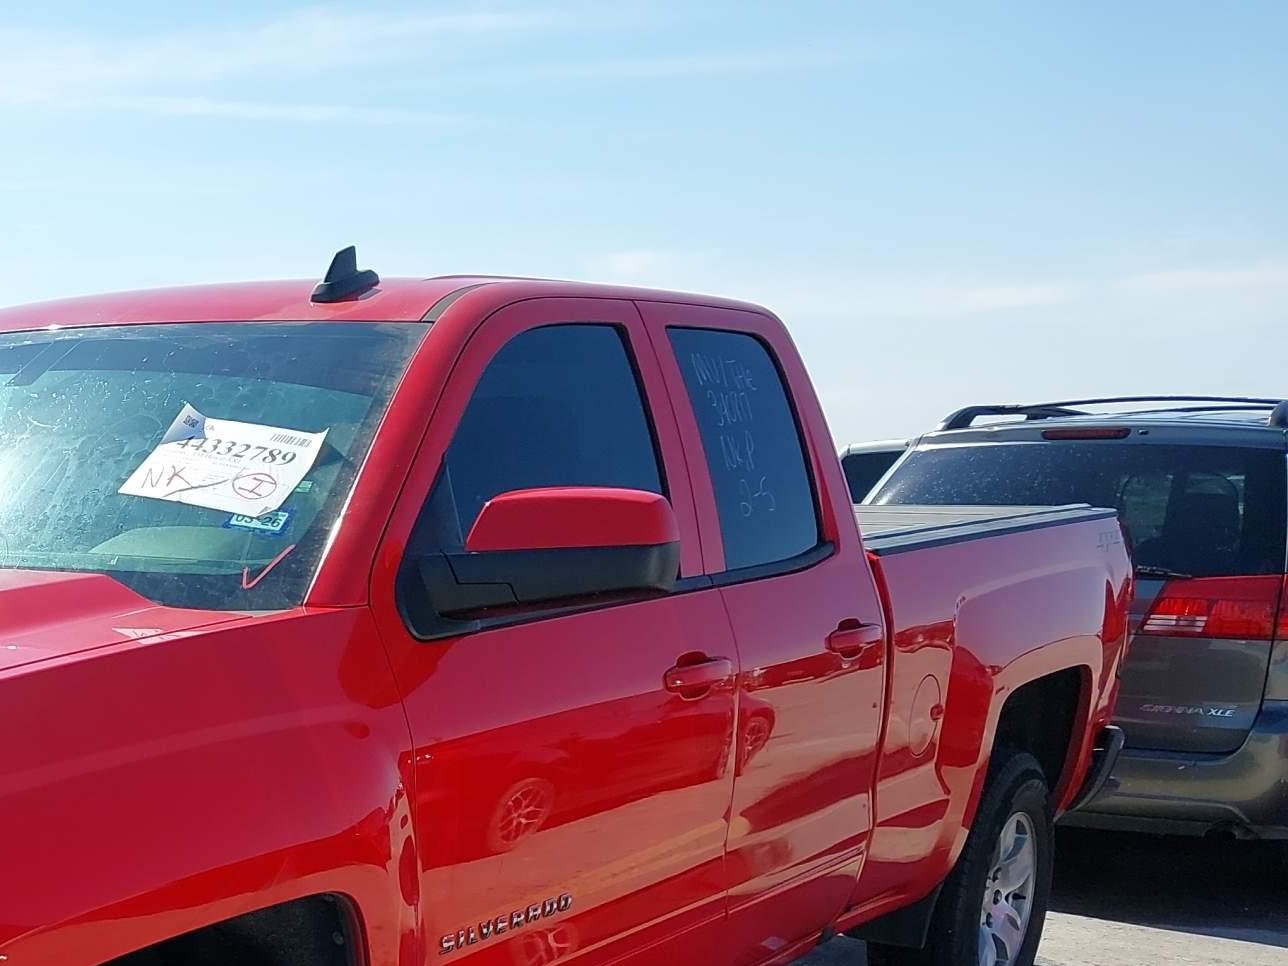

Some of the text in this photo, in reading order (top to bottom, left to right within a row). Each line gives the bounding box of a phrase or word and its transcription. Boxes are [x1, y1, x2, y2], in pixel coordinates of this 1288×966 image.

[176, 436, 297, 465] 44332789
[1207, 707, 1236, 717] XLE
[439, 892, 572, 955] SILVERADO
